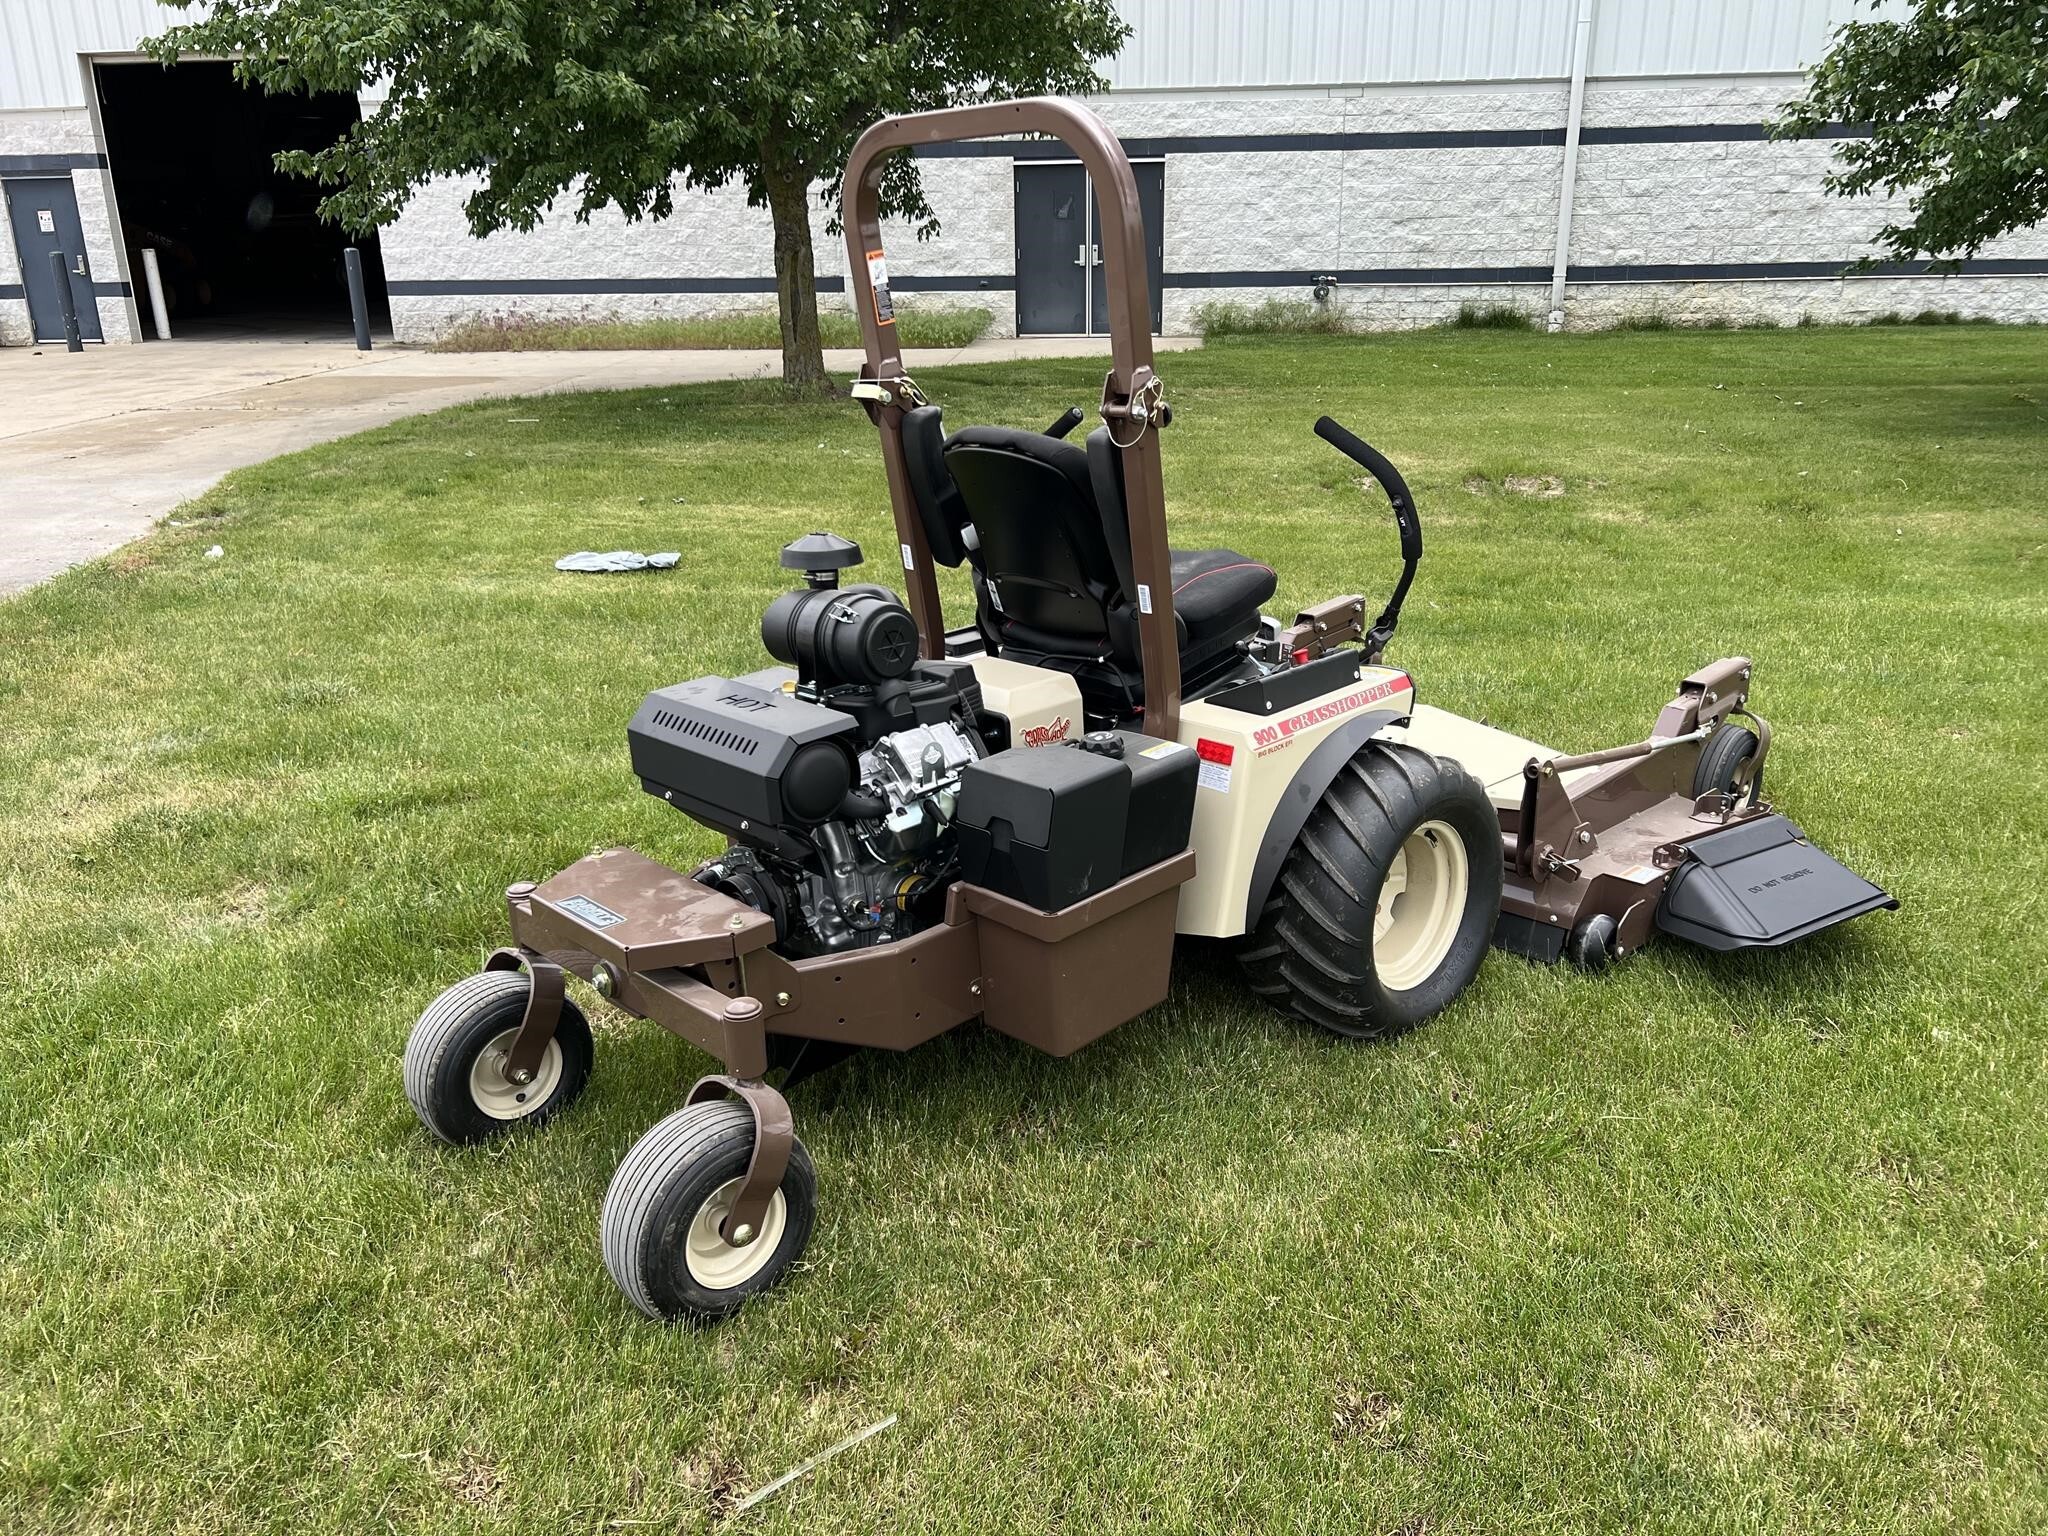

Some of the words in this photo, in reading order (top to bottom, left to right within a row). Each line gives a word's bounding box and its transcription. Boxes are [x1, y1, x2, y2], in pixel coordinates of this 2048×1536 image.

[147, 231, 174, 247] CASE
[715, 694, 778, 712] HOT
[1253, 726, 1278, 746] 900
[1288, 682, 1394, 731] GRASSHOPPER
[1257, 749, 1267, 758] BIG
[1267, 744, 1284, 754] BLOCK
[1747, 885, 1762, 893] DO
[1762, 879, 1780, 888] NOT
[1780, 868, 1813, 880] REMOVE
